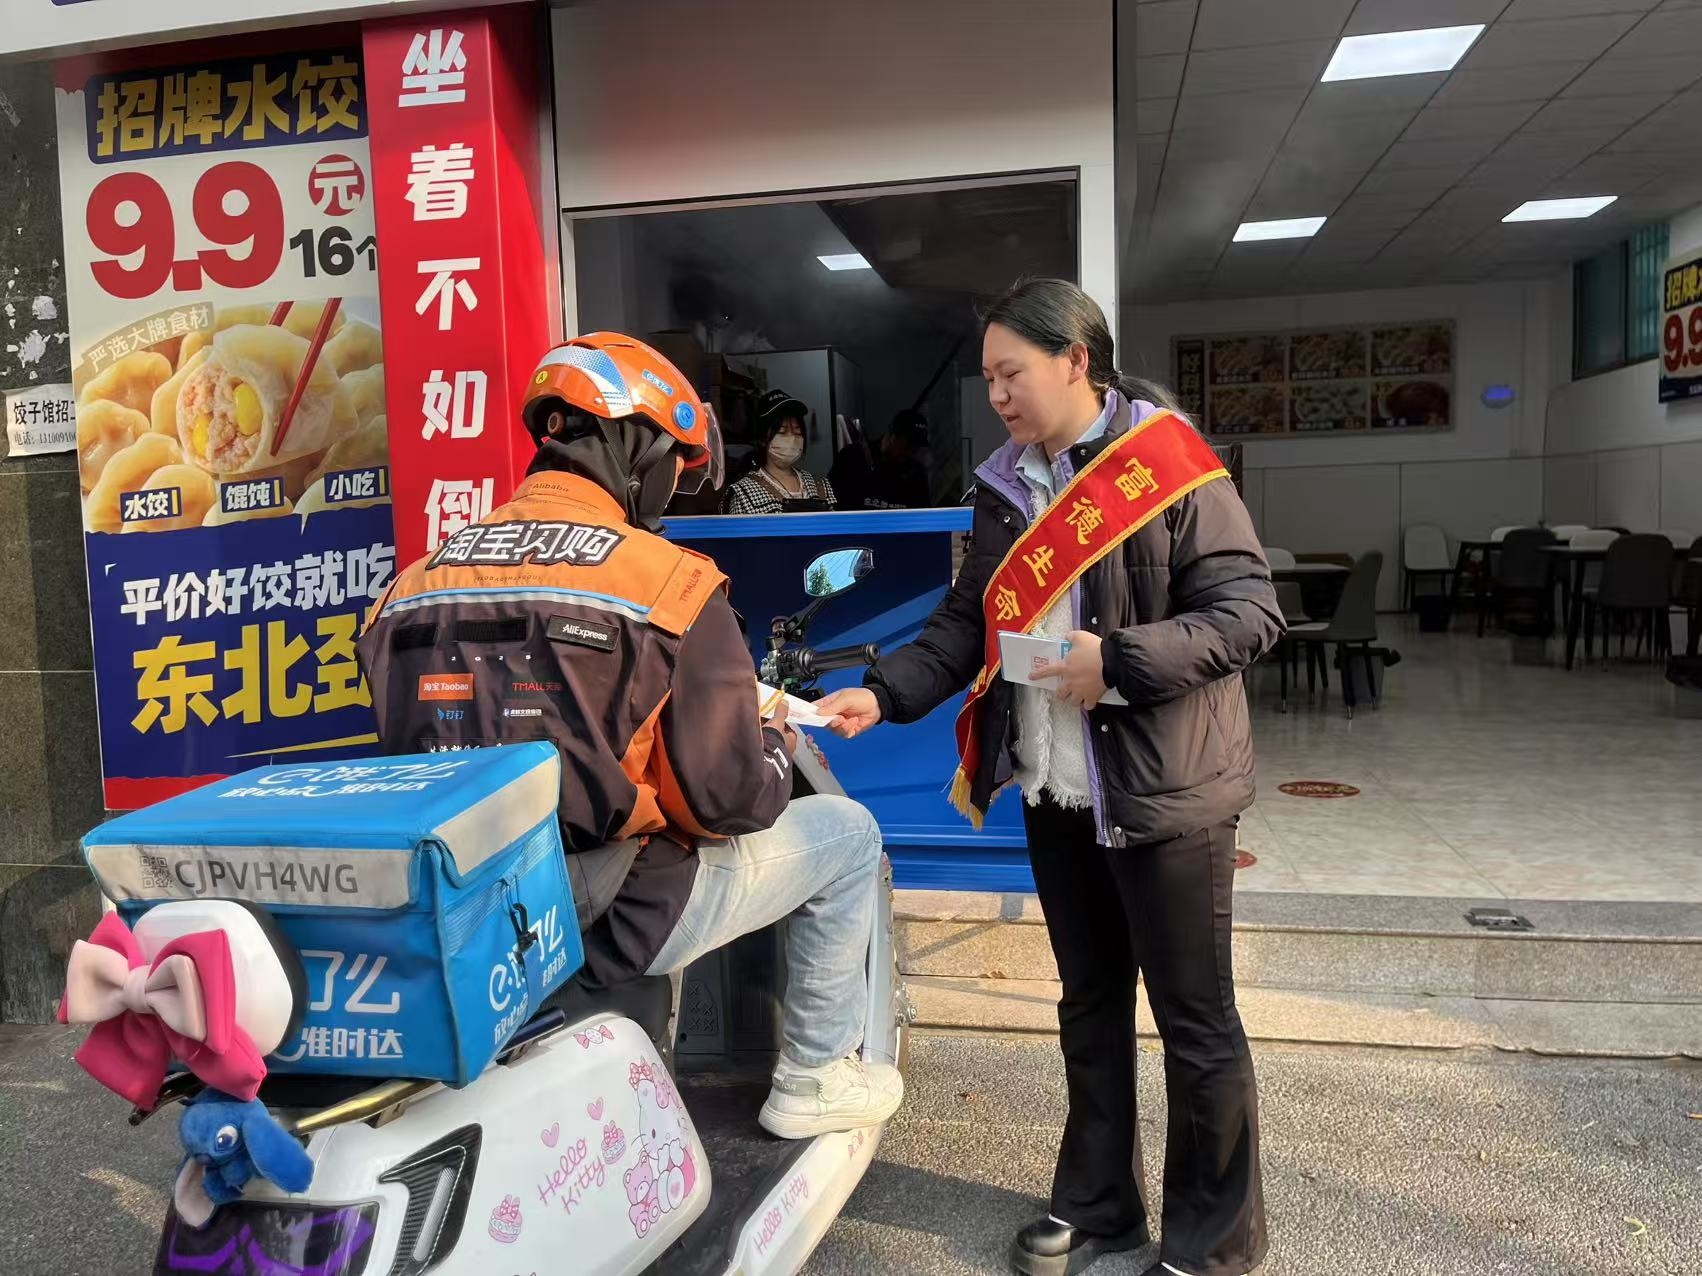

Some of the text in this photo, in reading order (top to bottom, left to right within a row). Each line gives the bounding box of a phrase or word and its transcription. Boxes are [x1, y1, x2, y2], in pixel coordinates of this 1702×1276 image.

[97, 56, 358, 156] 招牌水饺
[313, 160, 362, 213] 元
[86, 161, 284, 299] 9.9
[88, 304, 209, 374] 严选大牌食材
[124, 494, 169, 519] 水饺
[225, 482, 271, 510] 馄饨
[328, 471, 375, 500] 小吃
[434, 522, 620, 562] 淘宝闪购
[120, 543, 397, 625] 平价好饺就吃
[562, 623, 608, 641] AliExpress
[446, 710, 465, 720] 钉钉
[173, 860, 358, 894] CJPVH4WG
[301, 1026, 404, 1058] 准时达
[537, 1137, 587, 1206] Hello
[561, 1155, 605, 1215] Kitty
[753, 1174, 809, 1256] Hello Kitty
